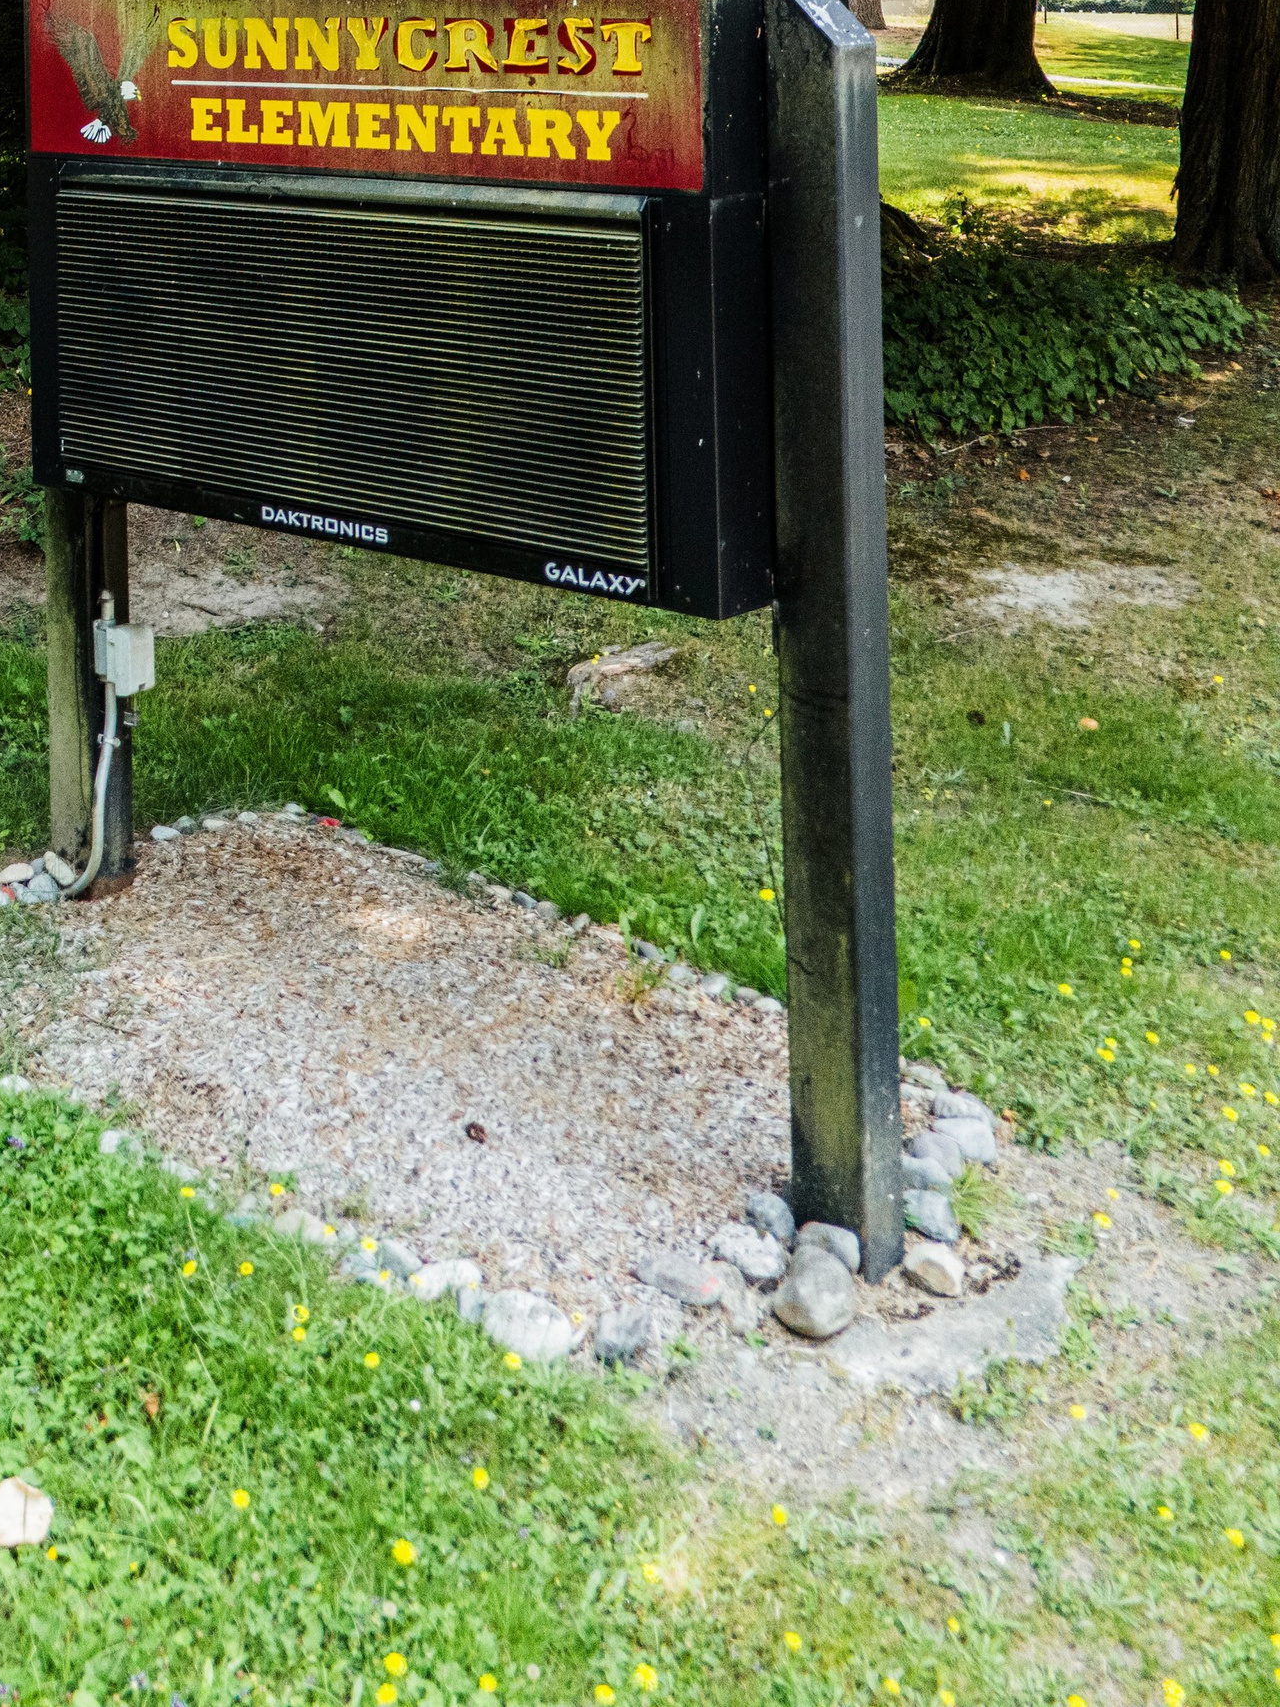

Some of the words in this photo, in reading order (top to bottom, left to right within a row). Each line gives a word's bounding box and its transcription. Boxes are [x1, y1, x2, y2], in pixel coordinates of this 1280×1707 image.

[168, 16, 652, 75] SUNNYCREST
[191, 97, 620, 161] ELEMENTARY
[261, 505, 389, 544] DAKTRONICS
[545, 561, 642, 595] GALAXY
